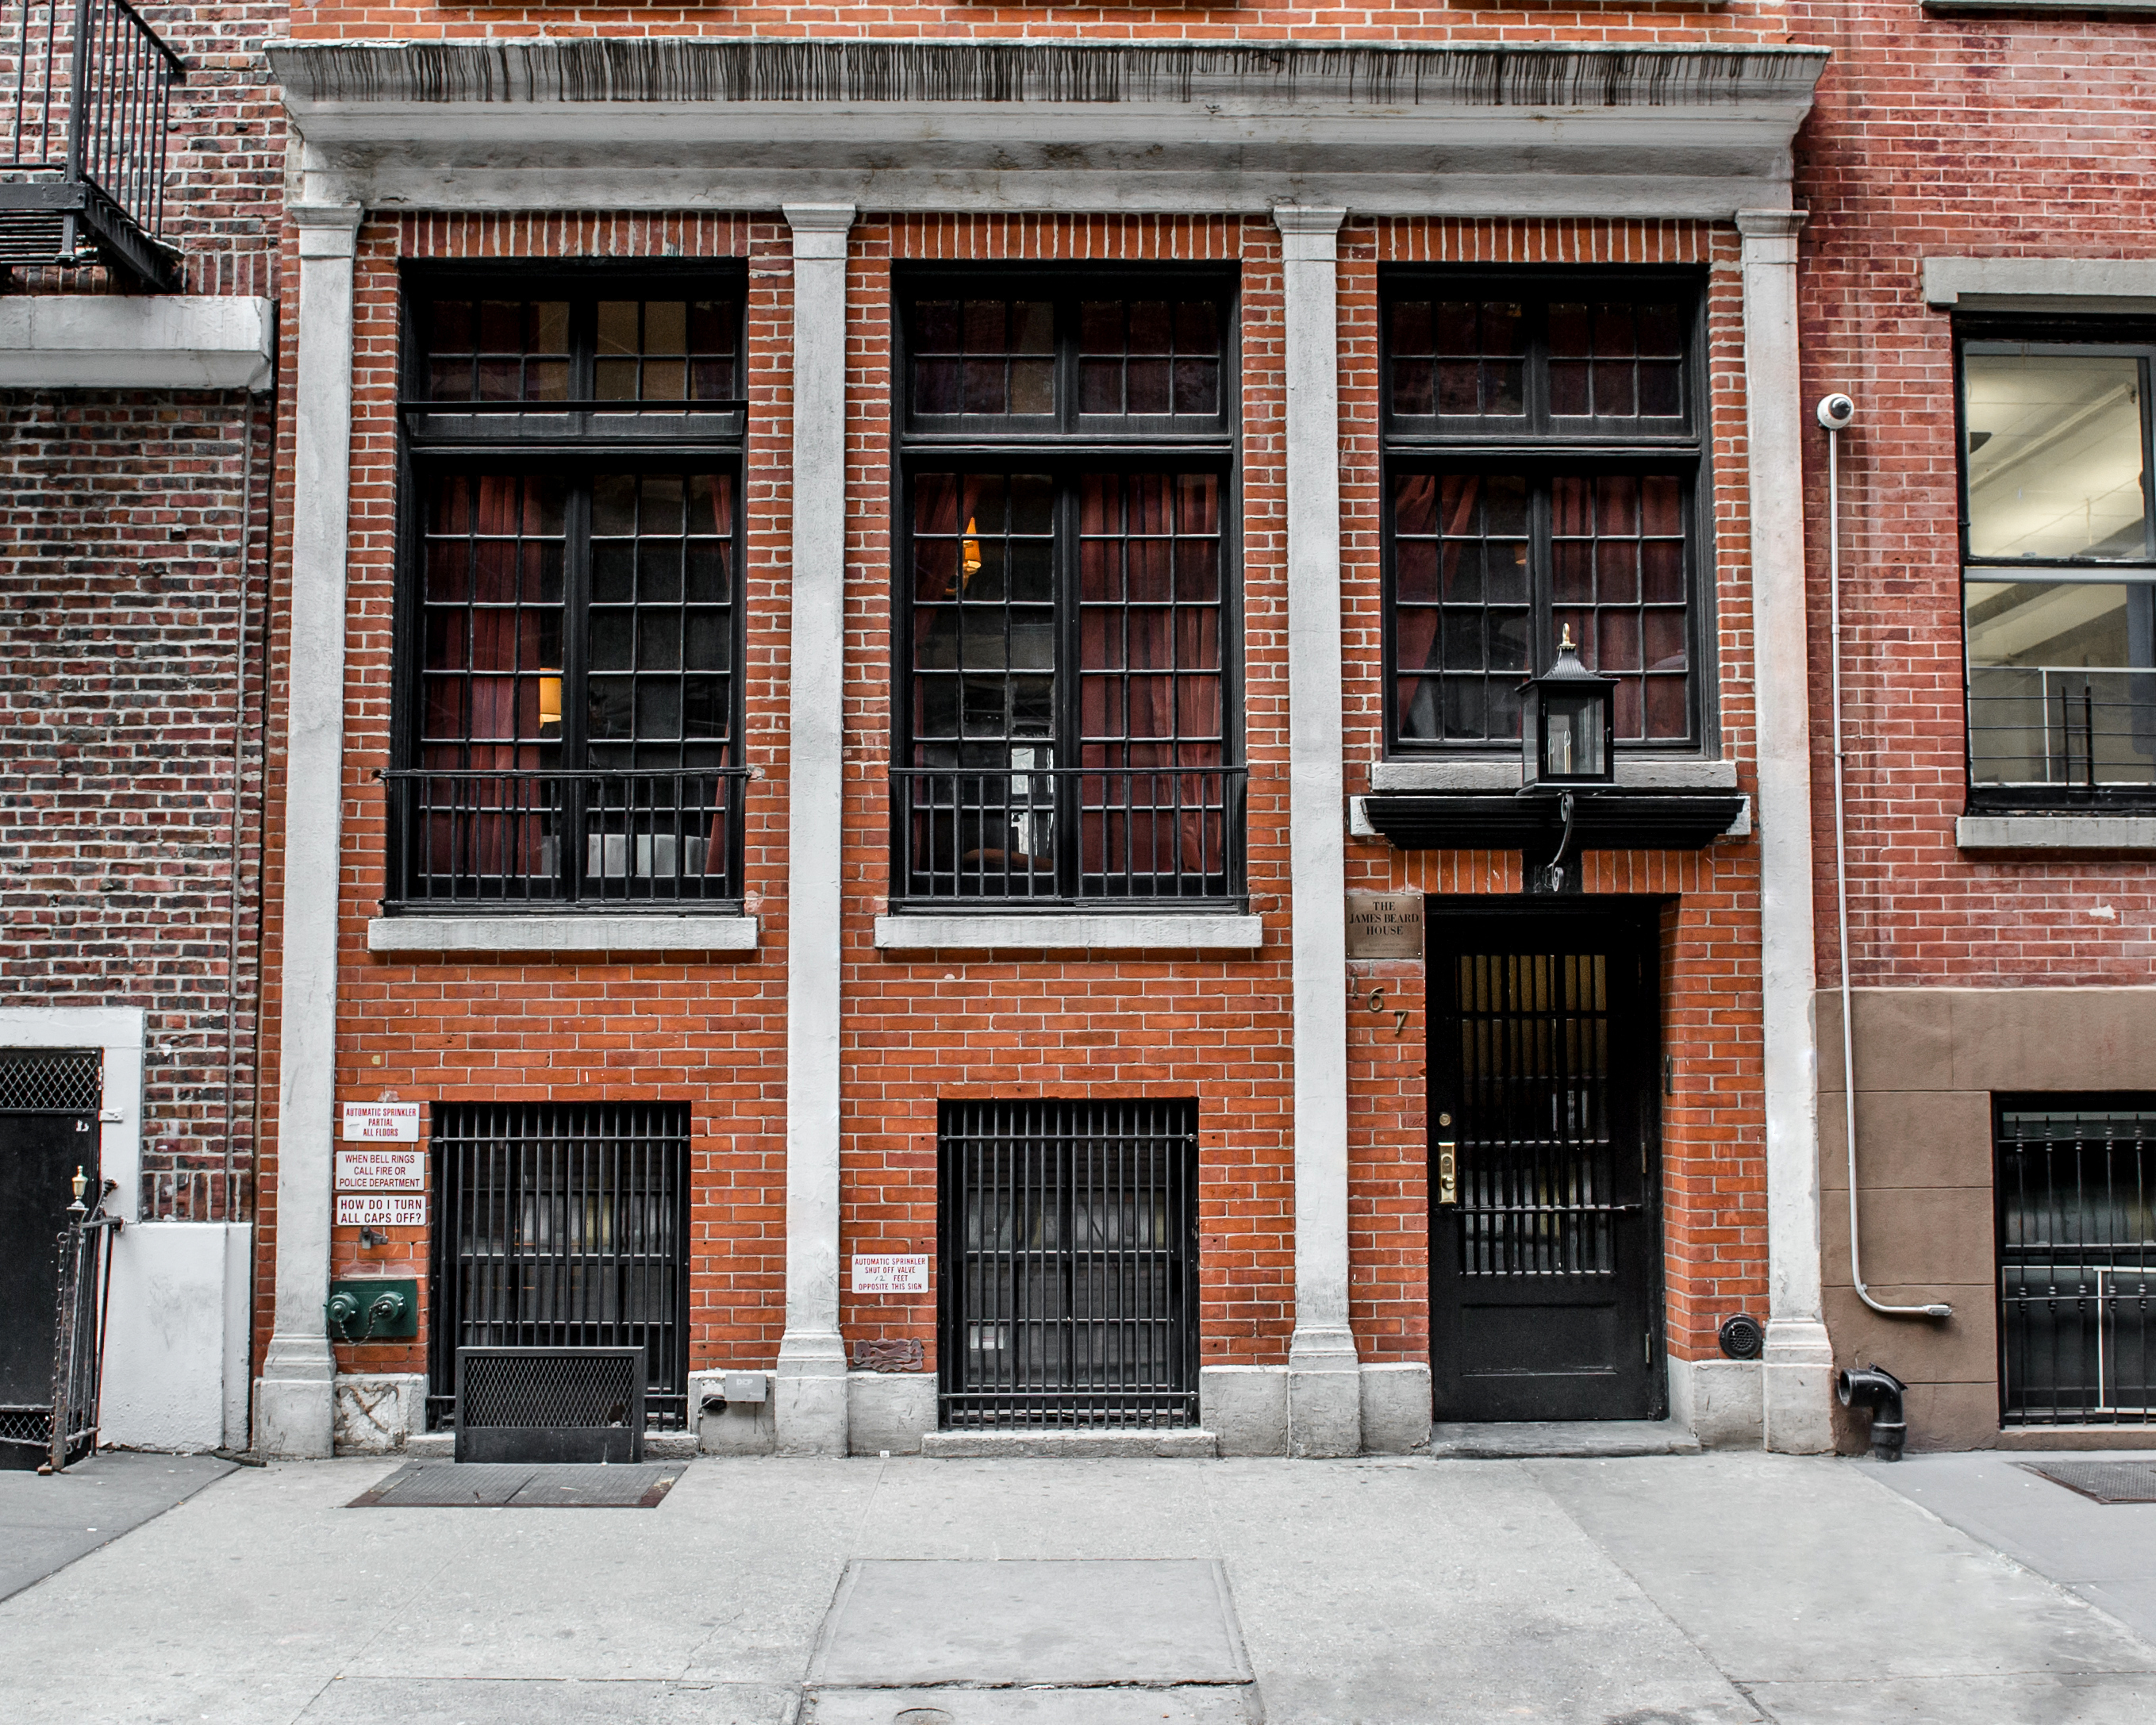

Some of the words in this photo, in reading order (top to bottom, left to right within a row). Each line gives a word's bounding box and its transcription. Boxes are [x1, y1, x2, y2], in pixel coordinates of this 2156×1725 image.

[1373, 901, 1396, 911] THE
[1350, 914, 1382, 924] JAMES
[1384, 914, 1420, 924] BEARD
[1366, 926, 1404, 935] HOUSE
[346, 1108, 381, 1116] AUTOMATIC
[382, 1108, 417, 1116] SPRINKLER
[368, 1118, 394, 1127] PARTIAL
[375, 1128, 398, 1137] FLOORS
[345, 1154, 368, 1163] WHEN
[370, 1154, 390, 1163] BELL
[391, 1154, 415, 1163] RINGS
[354, 1166, 374, 1175] CALL
[375, 1166, 393, 1175] FIRE
[394, 1166, 406, 1175] OR
[339, 1178, 367, 1187] POLICE
[369, 1178, 420, 1187] DEPARTMENT
[340, 1199, 364, 1209] HOW
[369, 1199, 382, 1209] DO
[387, 1199, 390, 1209] I
[394, 1199, 422, 1209] TURN
[340, 1212, 360, 1223] ALL
[364, 1212, 392, 1223] CAPS
[396, 1212, 421, 1223] OFF?
